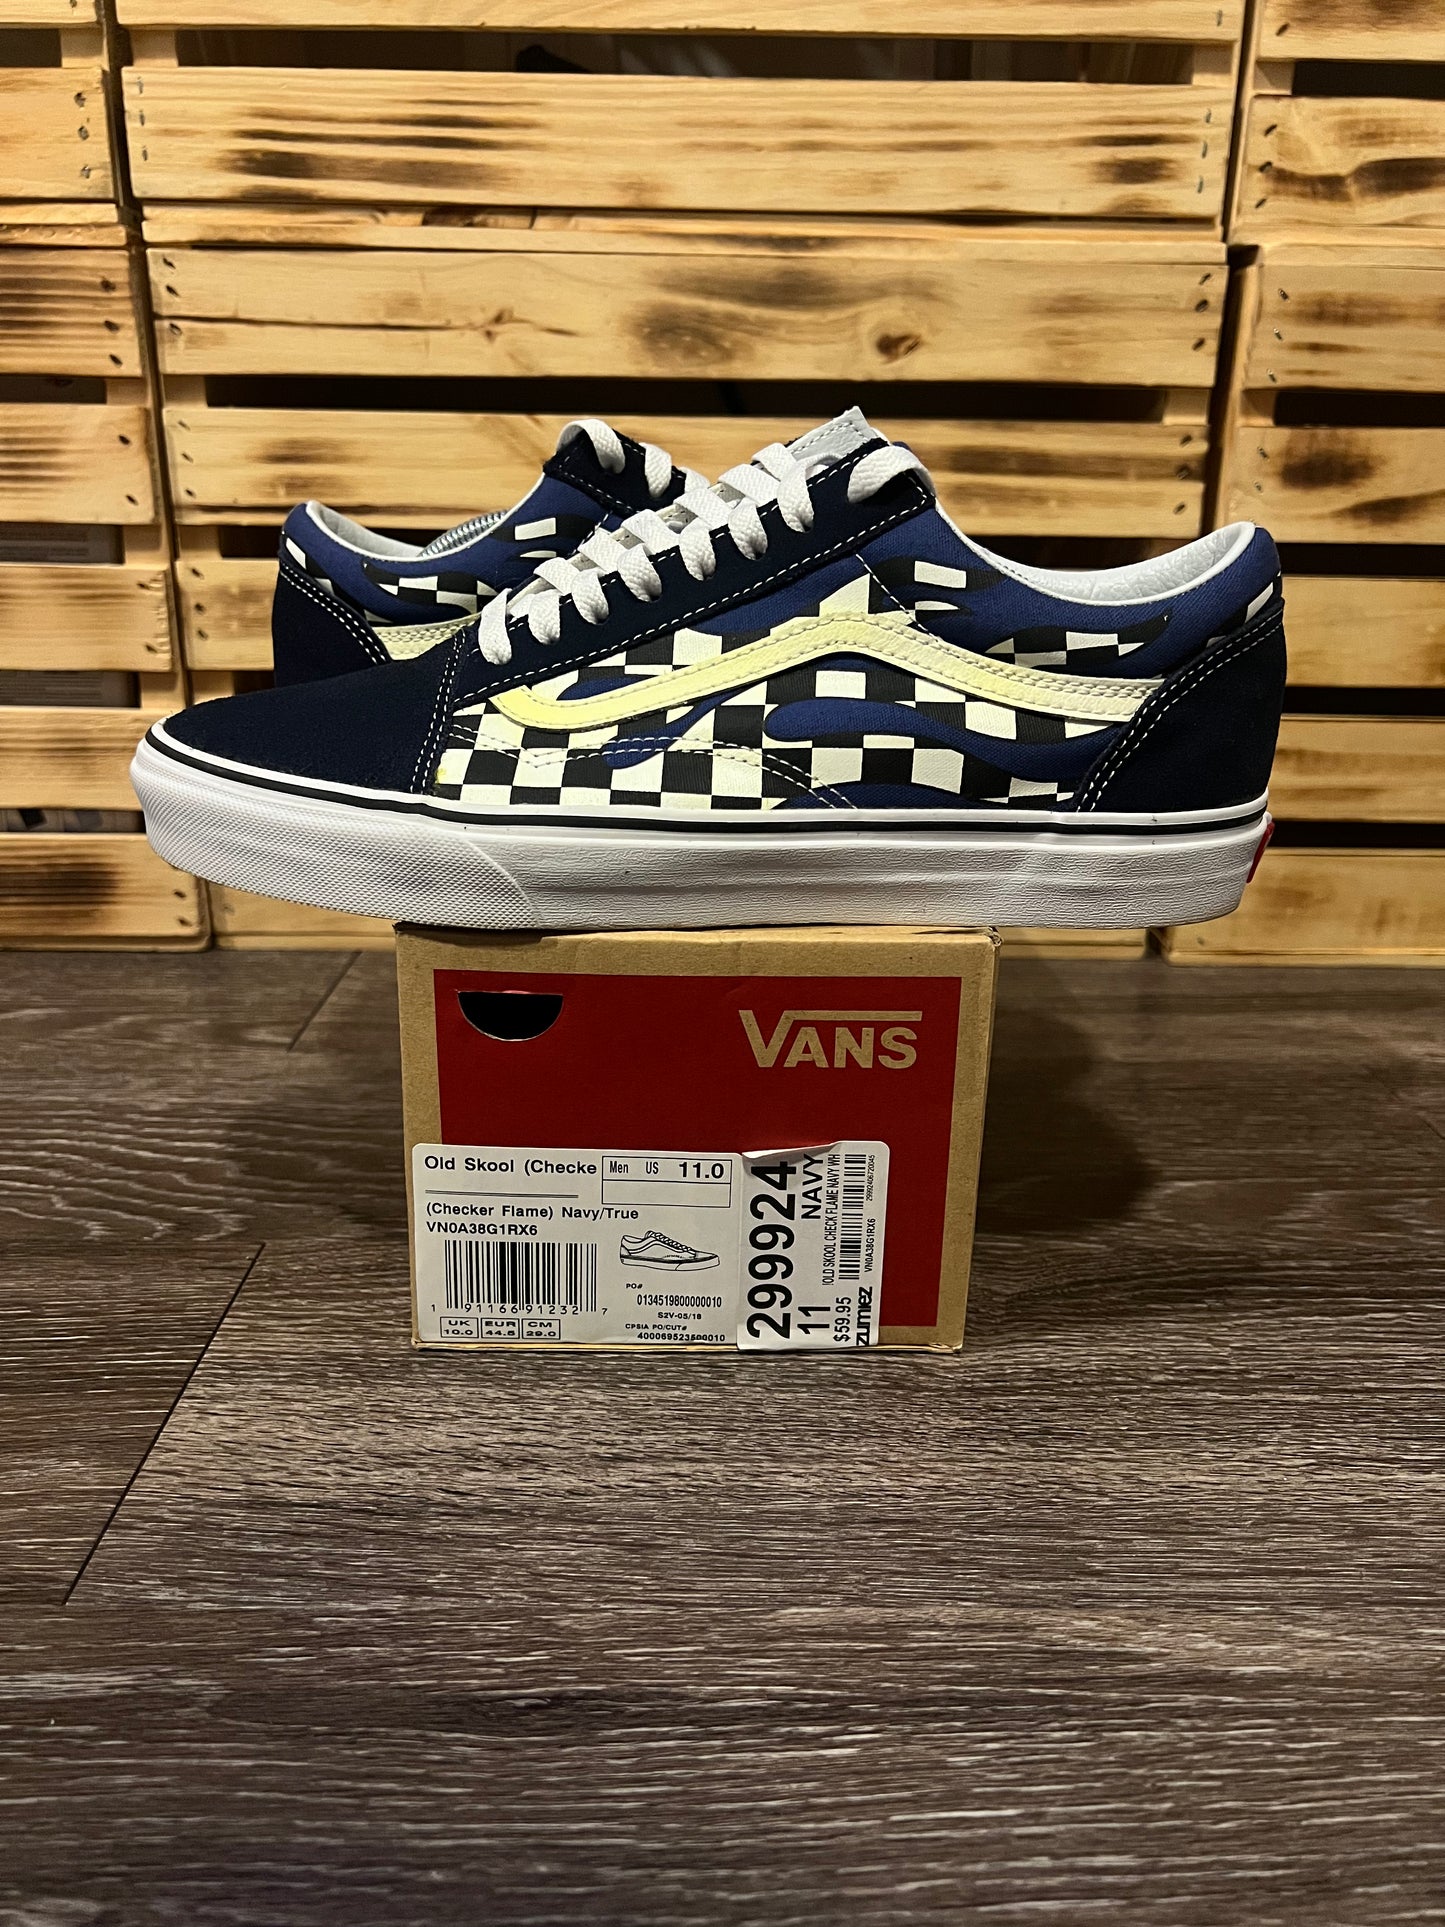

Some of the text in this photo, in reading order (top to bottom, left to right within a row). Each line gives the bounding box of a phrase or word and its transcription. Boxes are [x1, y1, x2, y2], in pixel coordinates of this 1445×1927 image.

[738, 1009, 923, 1070] VANS
[425, 1156, 597, 1176] Old Skool (Checke
[610, 1161, 724, 1179] Men US 11.0
[828, 1154, 840, 1166] WH
[801, 1154, 823, 1219] NAVY
[827, 1168, 840, 1188] NAVY
[426, 1203, 639, 1221] (Checker Flame) Navy/True
[826, 1190, 839, 1214] FLAME
[427, 1222, 538, 1235] VN0A38G1RX6
[825, 1216, 838, 1240] CHECK
[747, 1161, 796, 1339] 299924
[823, 1243, 836, 1267] SKOOL
[865, 1218, 876, 1272] VN0A38G1RX6
[637, 1295, 722, 1307] 0134519800000010
[797, 1306, 831, 1334] 11
[834, 1297, 852, 1342] $59.95
[856, 1287, 872, 1345] zumiez
